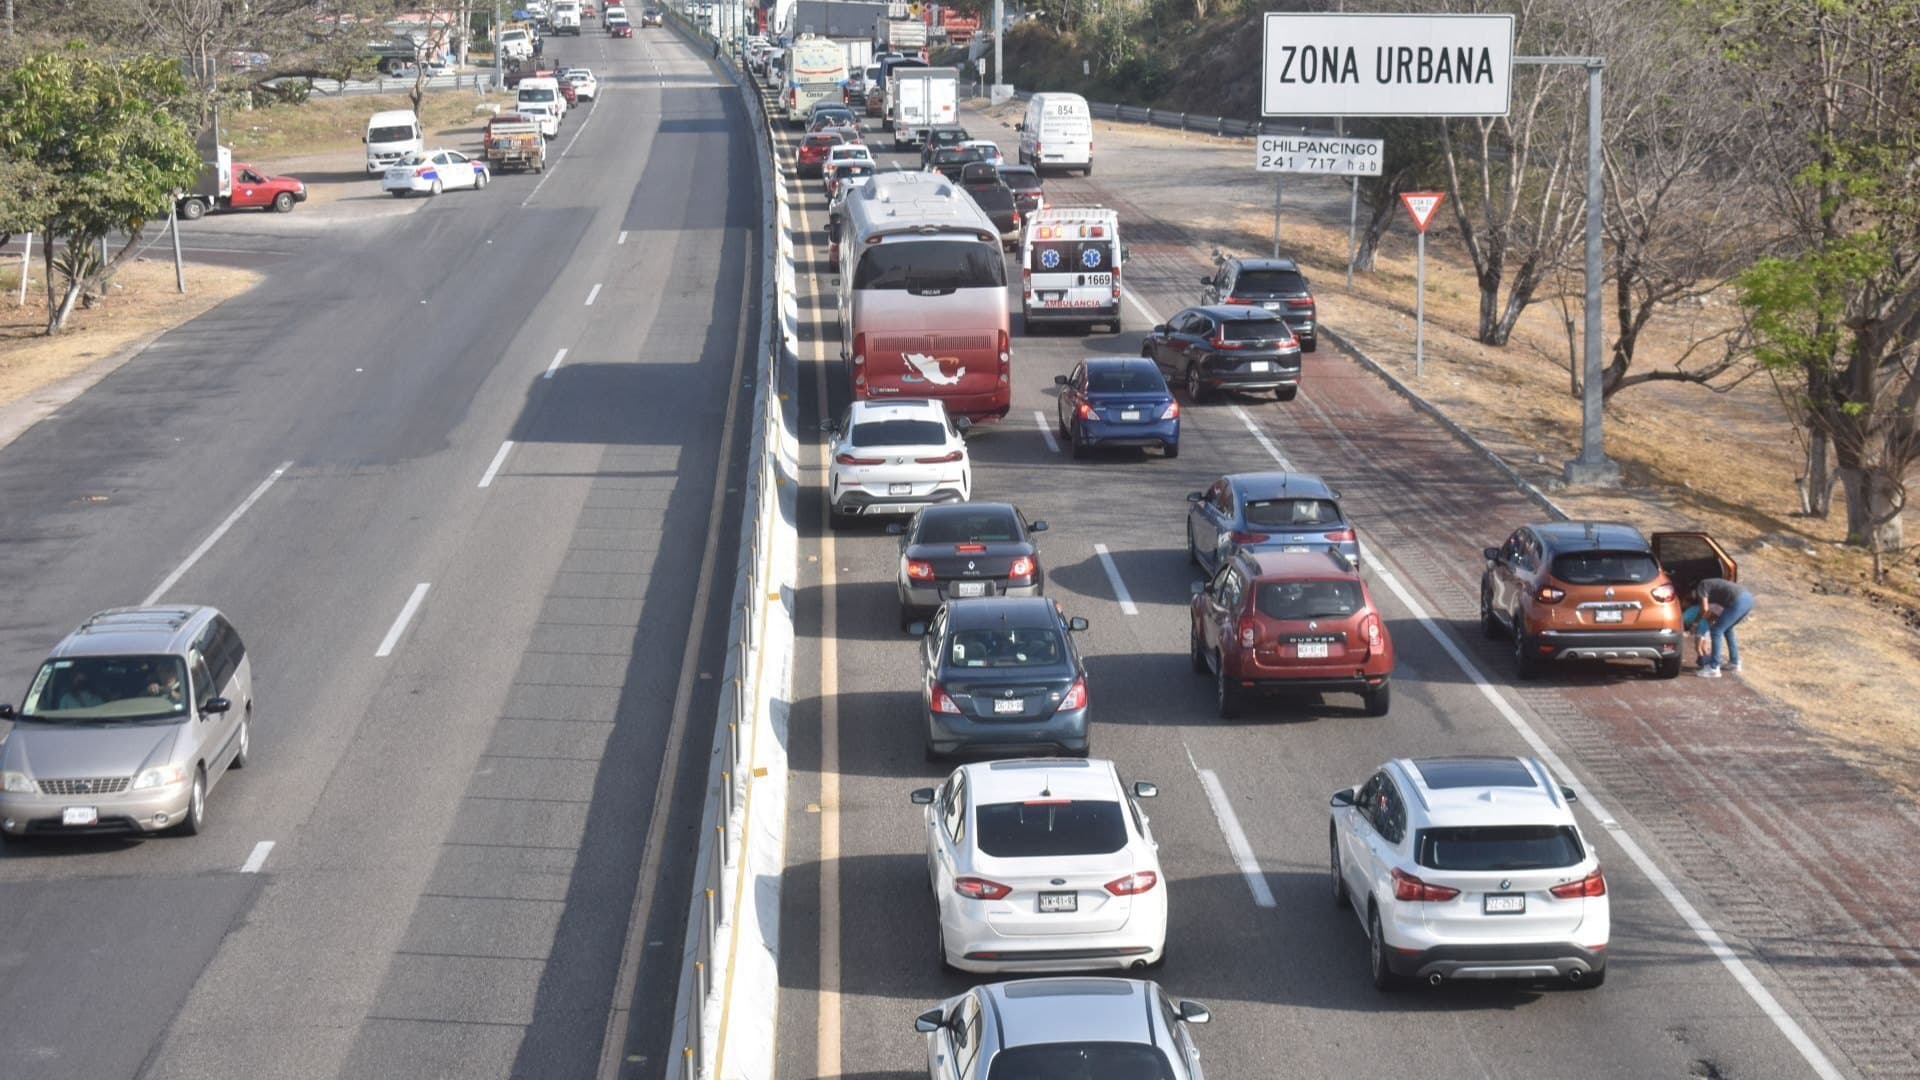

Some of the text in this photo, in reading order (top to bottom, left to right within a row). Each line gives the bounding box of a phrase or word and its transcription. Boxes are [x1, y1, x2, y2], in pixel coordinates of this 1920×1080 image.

[1280, 45, 1494, 84] ZONA URBANA
[1057, 104, 1073, 115] 854
[1262, 139, 1377, 156] CHILPANCINGO
[1261, 155, 1293, 168] 241
[1308, 157, 1336, 169] 717
[1087, 274, 1111, 285] 1669
[1043, 299, 1101, 308] AMBULANCIA
